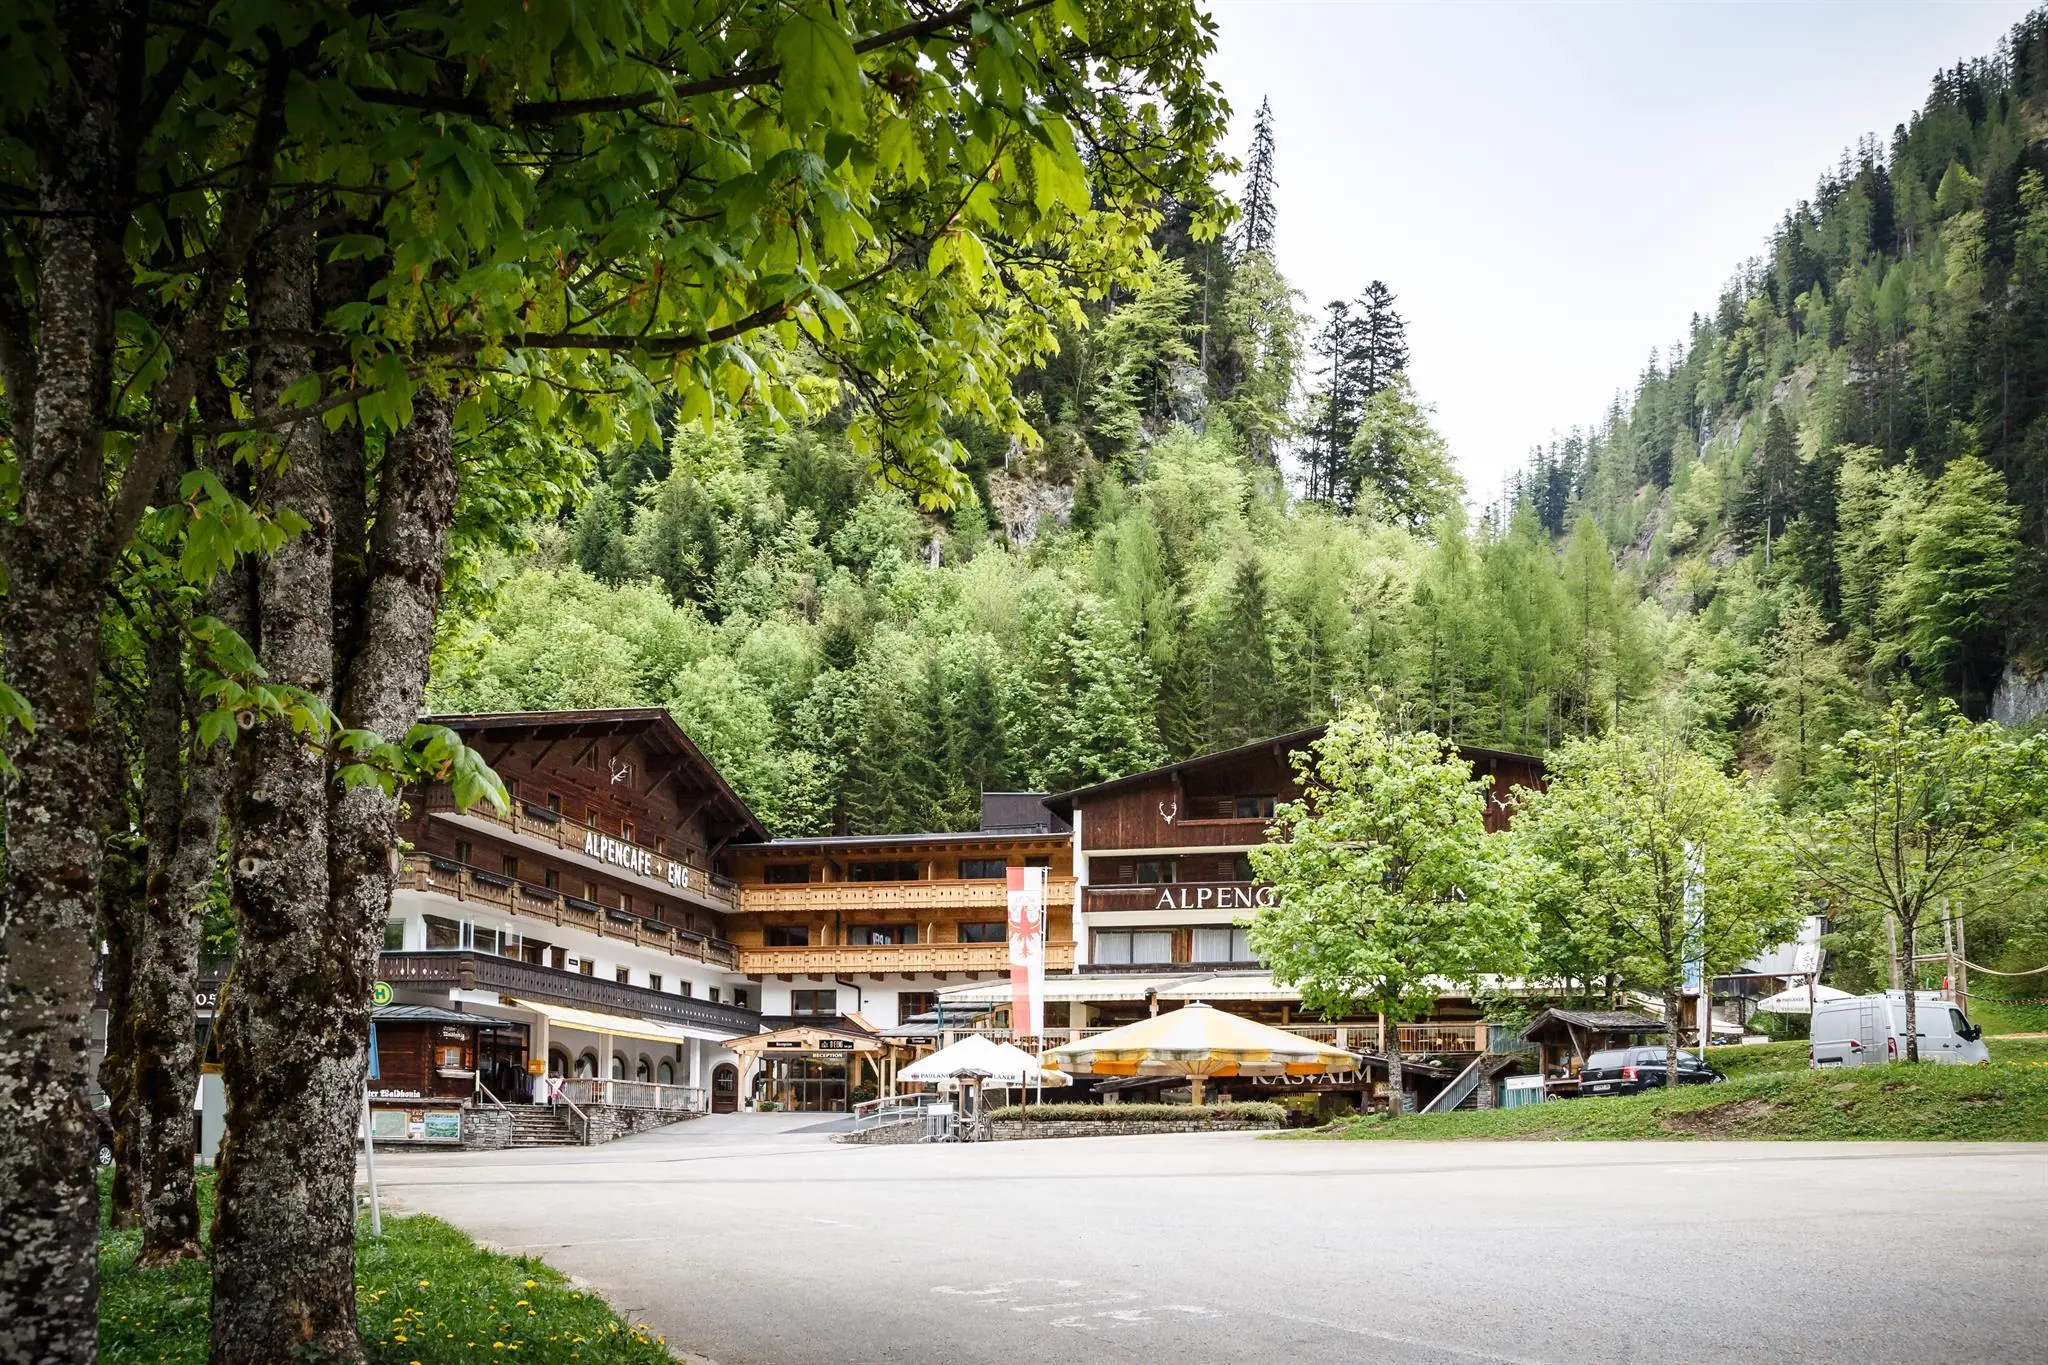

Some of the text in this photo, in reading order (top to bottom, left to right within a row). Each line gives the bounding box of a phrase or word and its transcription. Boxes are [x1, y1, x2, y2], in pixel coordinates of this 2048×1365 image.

[585, 832, 689, 888] ALPENCAFE ENG
[1155, 886, 1280, 909] ALPENG
[376, 989, 386, 999] H
